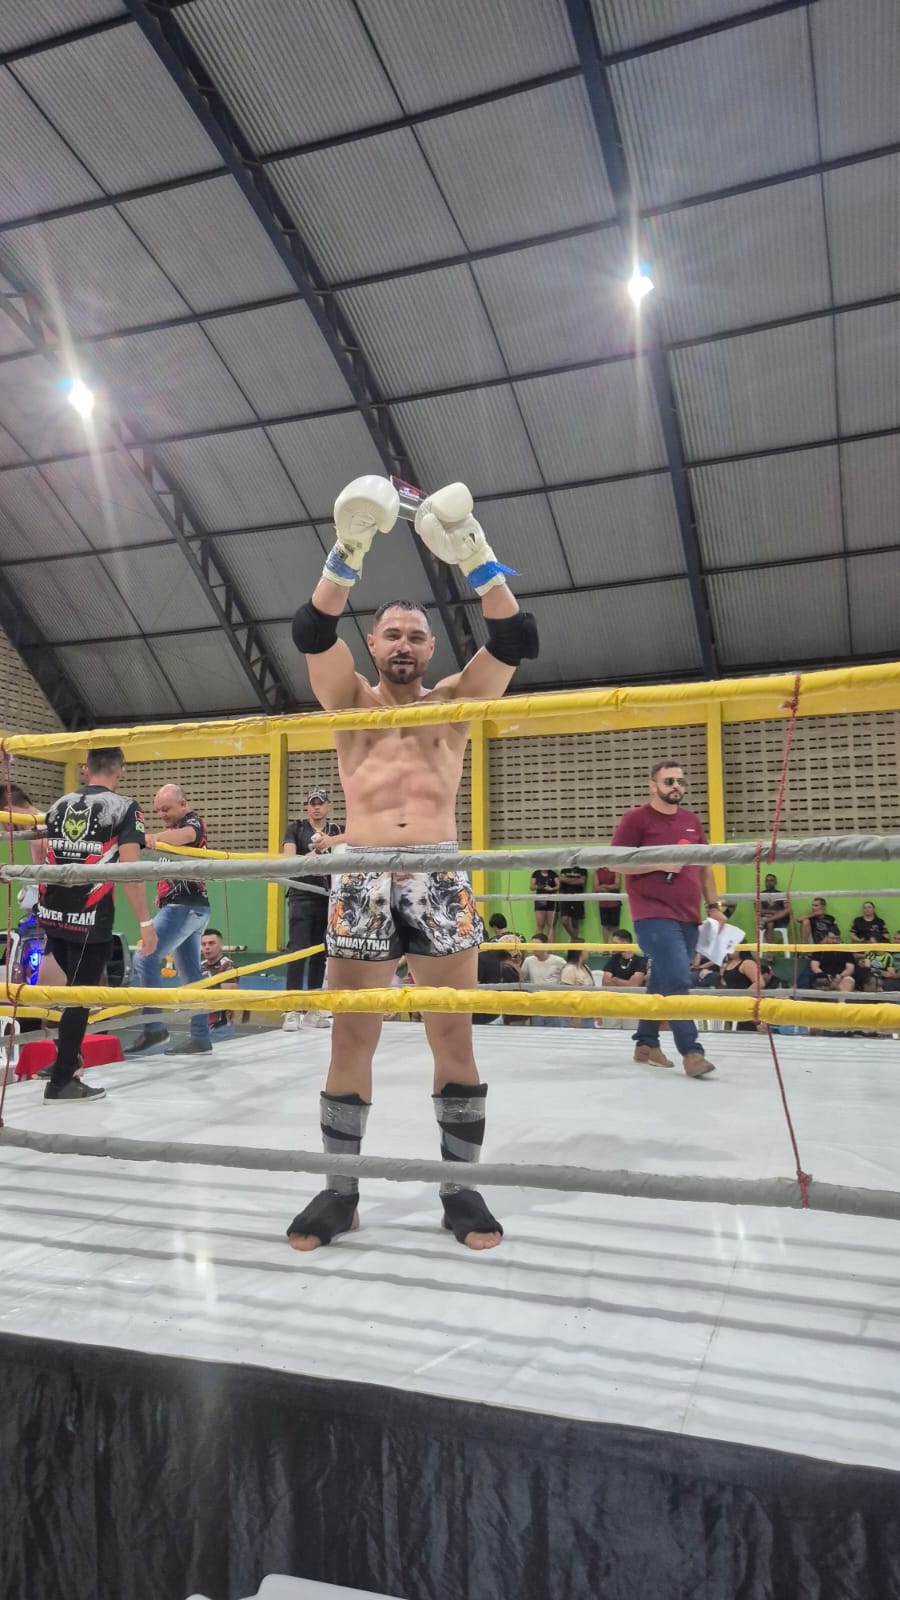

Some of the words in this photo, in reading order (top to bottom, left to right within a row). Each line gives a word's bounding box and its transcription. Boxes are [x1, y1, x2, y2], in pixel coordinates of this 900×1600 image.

[67, 911, 96, 926] TEAM
[337, 936, 365, 949] MUAY
[366, 940, 390, 951] THAI
